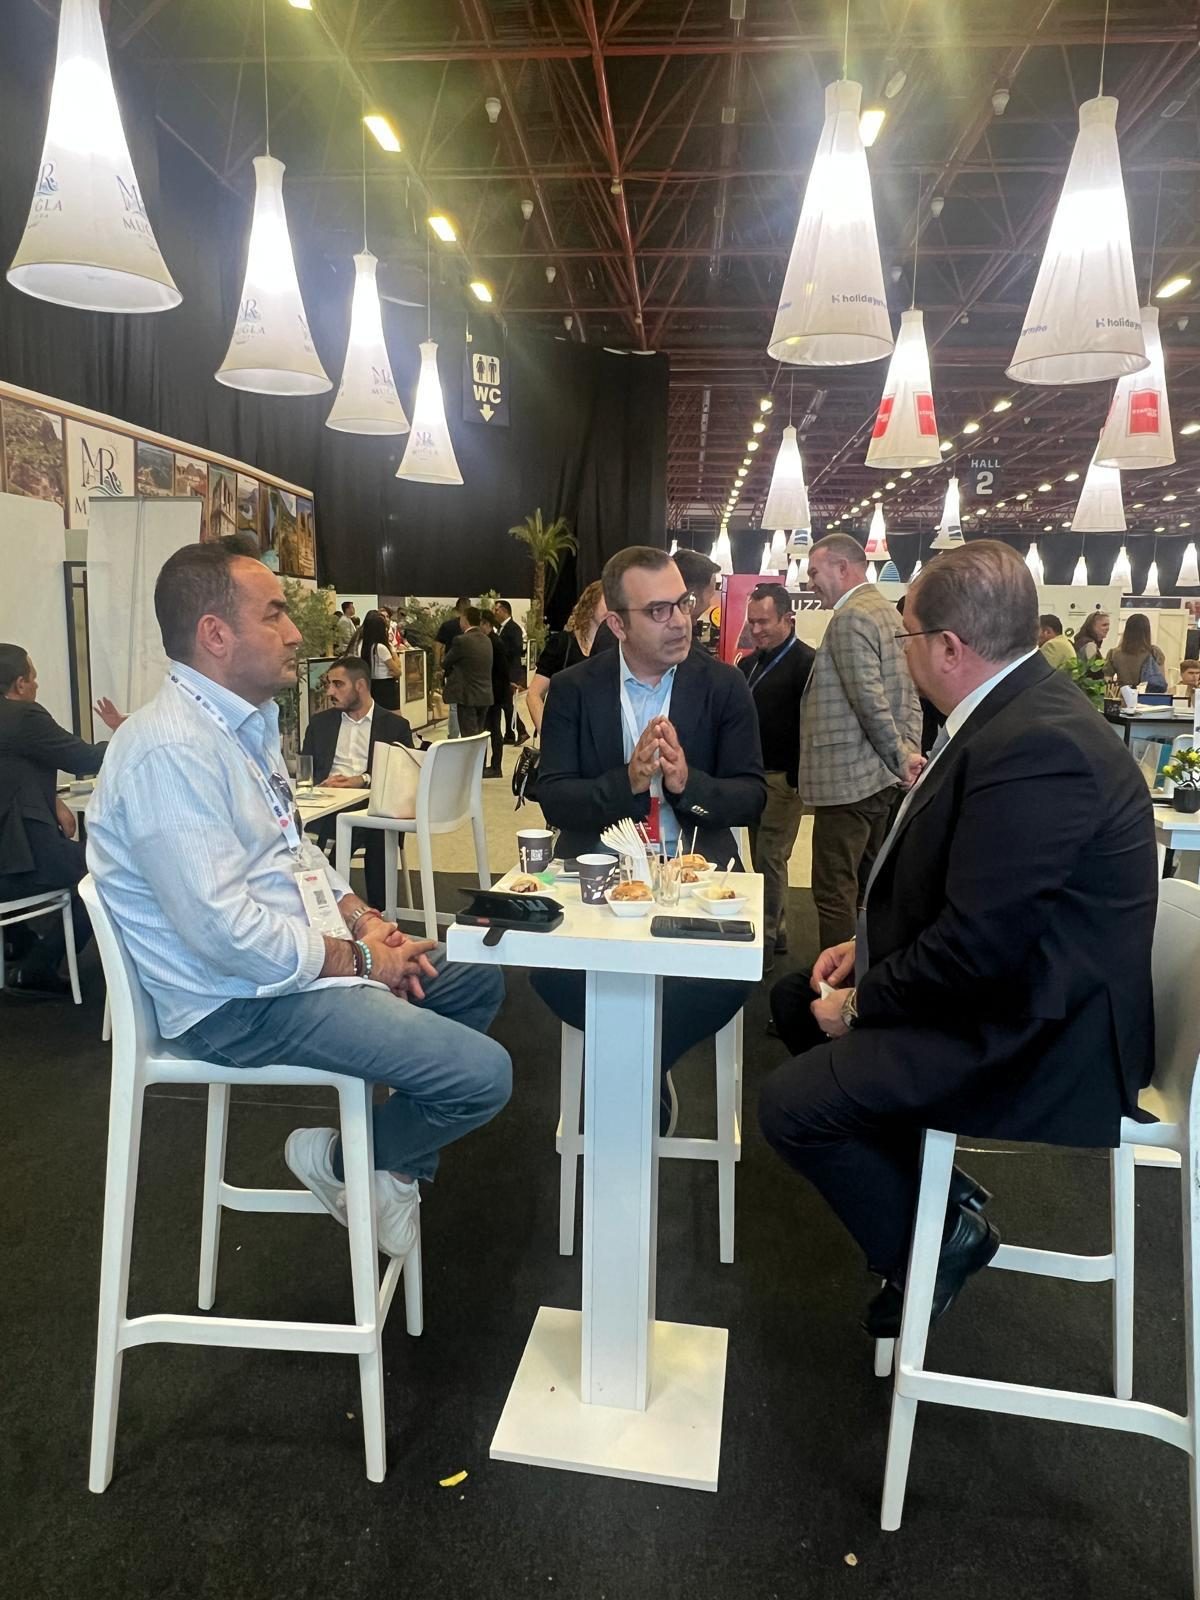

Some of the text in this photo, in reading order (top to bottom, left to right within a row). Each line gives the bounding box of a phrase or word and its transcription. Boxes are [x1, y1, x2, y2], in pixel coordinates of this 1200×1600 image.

[473, 384, 502, 404] WC
[970, 459, 1001, 469] HALL
[976, 470, 994, 495] 2
